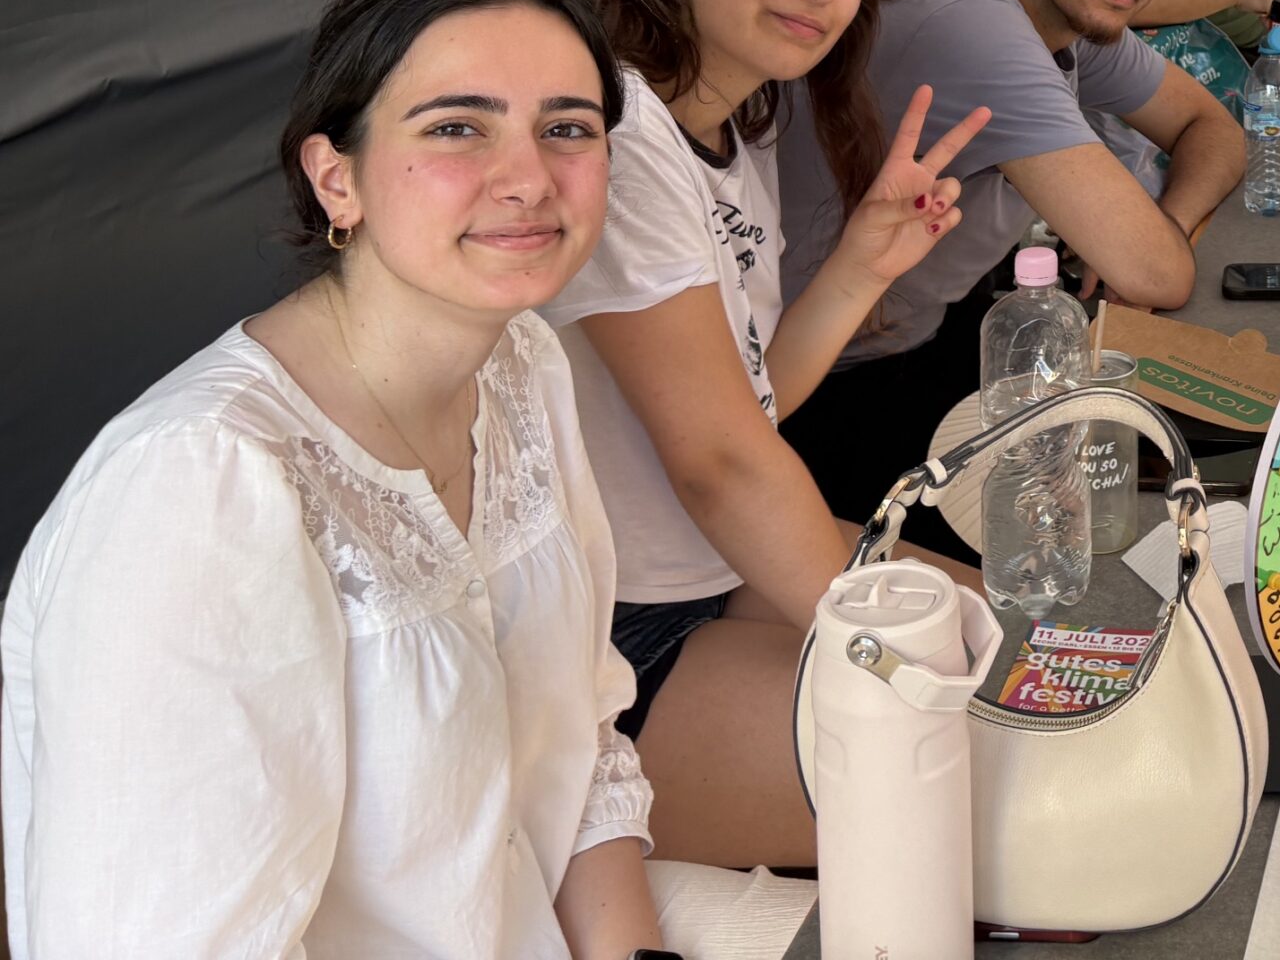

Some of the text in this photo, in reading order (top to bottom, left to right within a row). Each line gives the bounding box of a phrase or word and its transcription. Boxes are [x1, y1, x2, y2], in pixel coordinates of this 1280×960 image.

[1167, 354, 1277, 401] Deine Krankenkasse
[1142, 366, 1258, 416] novitas
[1081, 441, 1116, 457] LOVE
[1078, 458, 1118, 473] OU SO
[1037, 630, 1149, 648] 11. JULI 202
[1024, 652, 1122, 672] gutes
[1019, 682, 1118, 707] festiv
[1018, 702, 1036, 711] for
